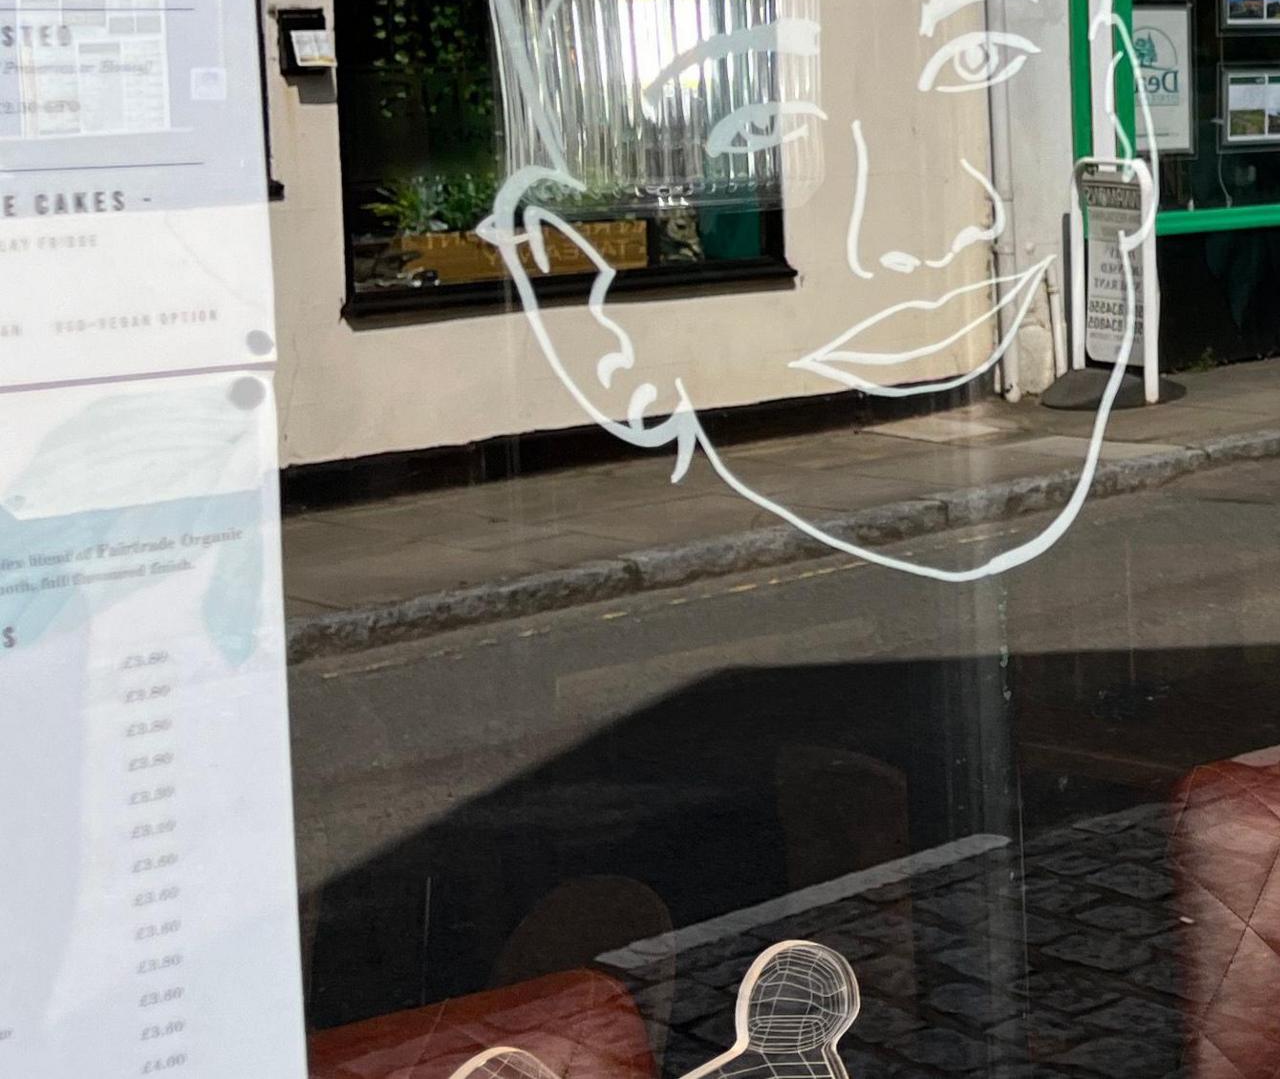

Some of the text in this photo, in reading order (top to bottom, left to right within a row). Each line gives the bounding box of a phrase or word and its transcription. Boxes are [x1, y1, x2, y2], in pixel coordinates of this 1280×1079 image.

[34, 190, 127, 216] CAKES
[95, 535, 176, 560] Fairtrade
[180, 527, 243, 550] Organic
